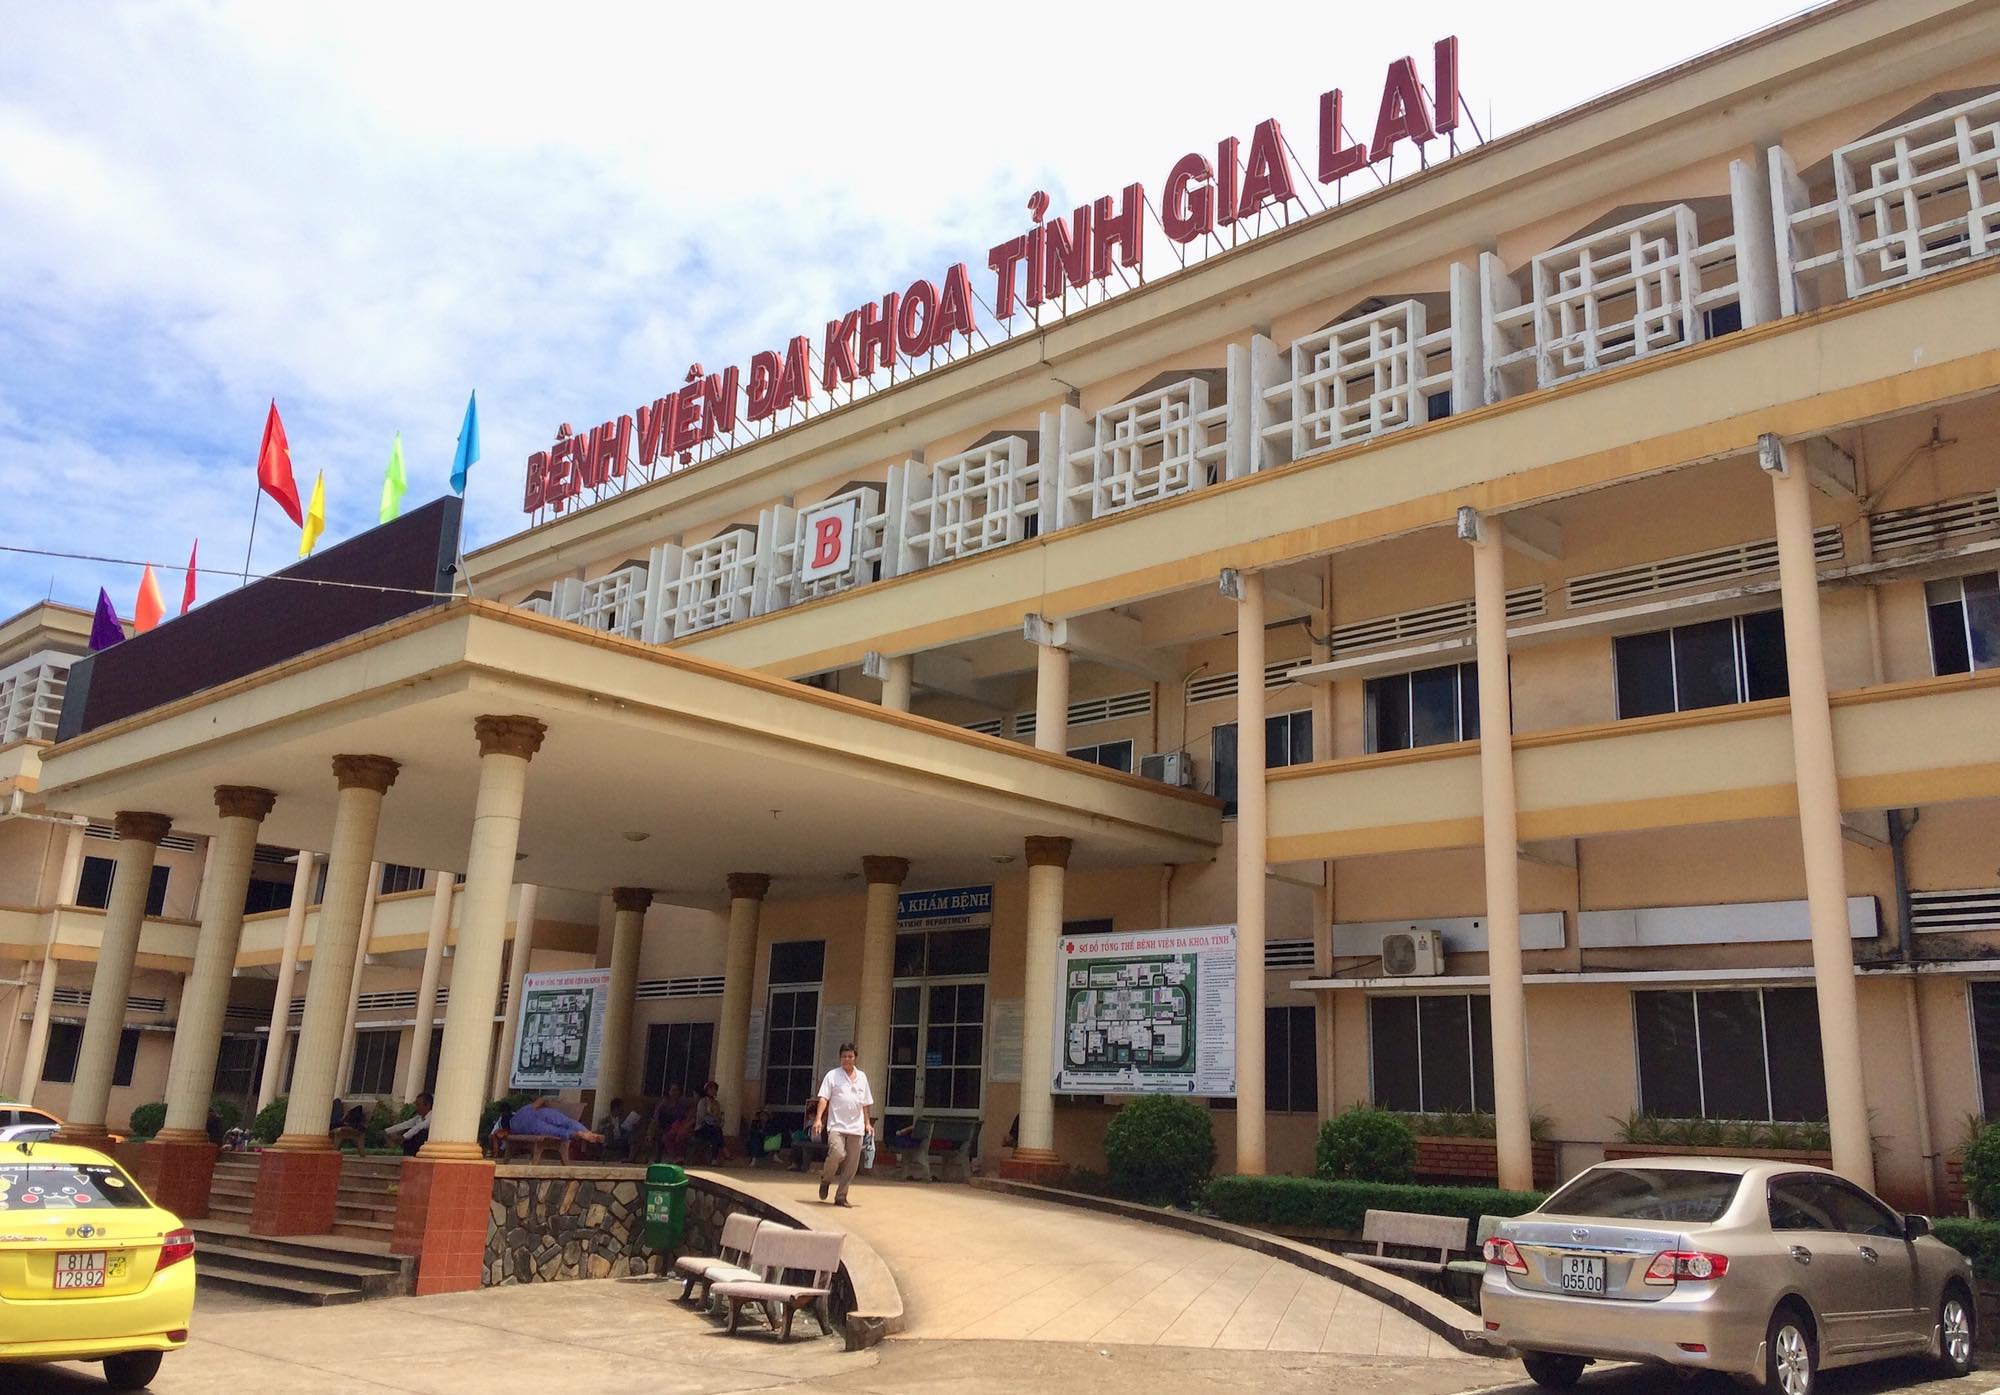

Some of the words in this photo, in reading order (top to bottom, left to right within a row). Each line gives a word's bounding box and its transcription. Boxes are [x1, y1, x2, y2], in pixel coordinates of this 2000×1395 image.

[523, 422, 632, 513] BỆNH
[636, 362, 739, 466] VIỆN
[746, 335, 812, 421] ĐA
[822, 262, 977, 392] KHOA
[987, 182, 1145, 321] TỈNH
[1162, 117, 1297, 245] GIA
[1318, 35, 1460, 185] LAI
[811, 516, 843, 570] B
[908, 893, 949, 913] KHÁM
[951, 891, 990, 911] BỆNH
[1136, 938, 1156, 950] BỆNH
[1188, 936, 1209, 948] KHOA
[68, 1254, 94, 1270] 81A
[1571, 1259, 1594, 1275] 81A
[57, 1271, 104, 1287] 128.92
[1563, 1275, 1602, 1292] 055.00
